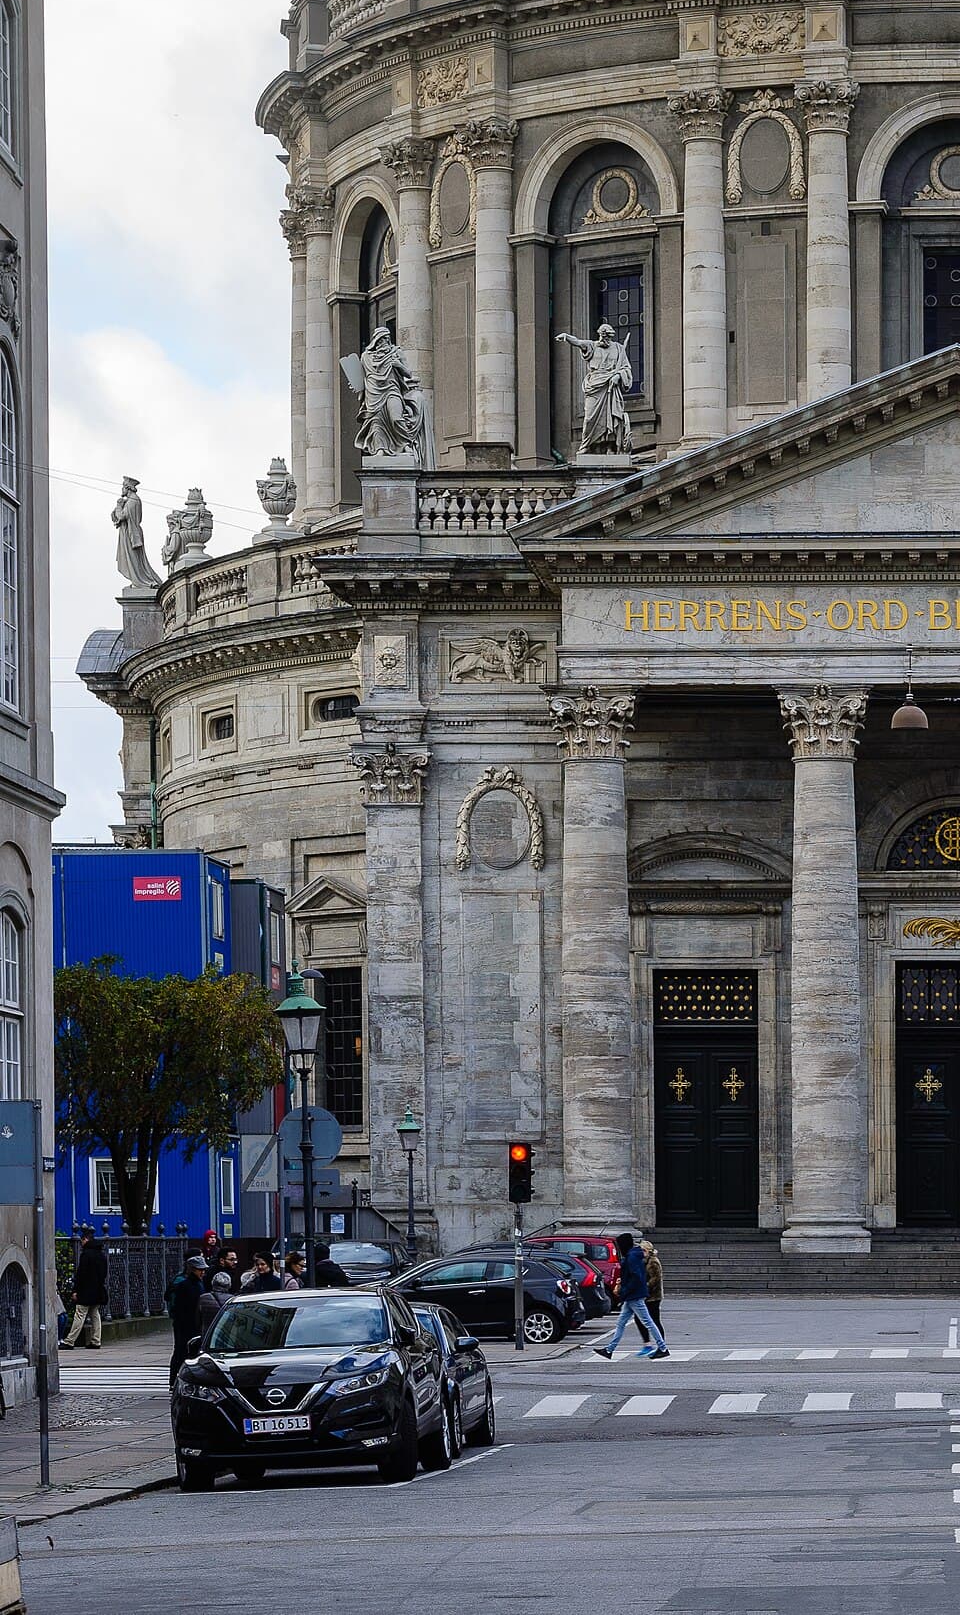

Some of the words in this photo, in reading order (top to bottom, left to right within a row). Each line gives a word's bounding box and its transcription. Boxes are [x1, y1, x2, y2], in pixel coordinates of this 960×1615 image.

[623, 599, 809, 631] HERRENS
[826, 599, 909, 631] ORD
[252, 1420, 268, 1431] BT
[271, 1419, 285, 1430] 16
[287, 1417, 309, 1429] 513
